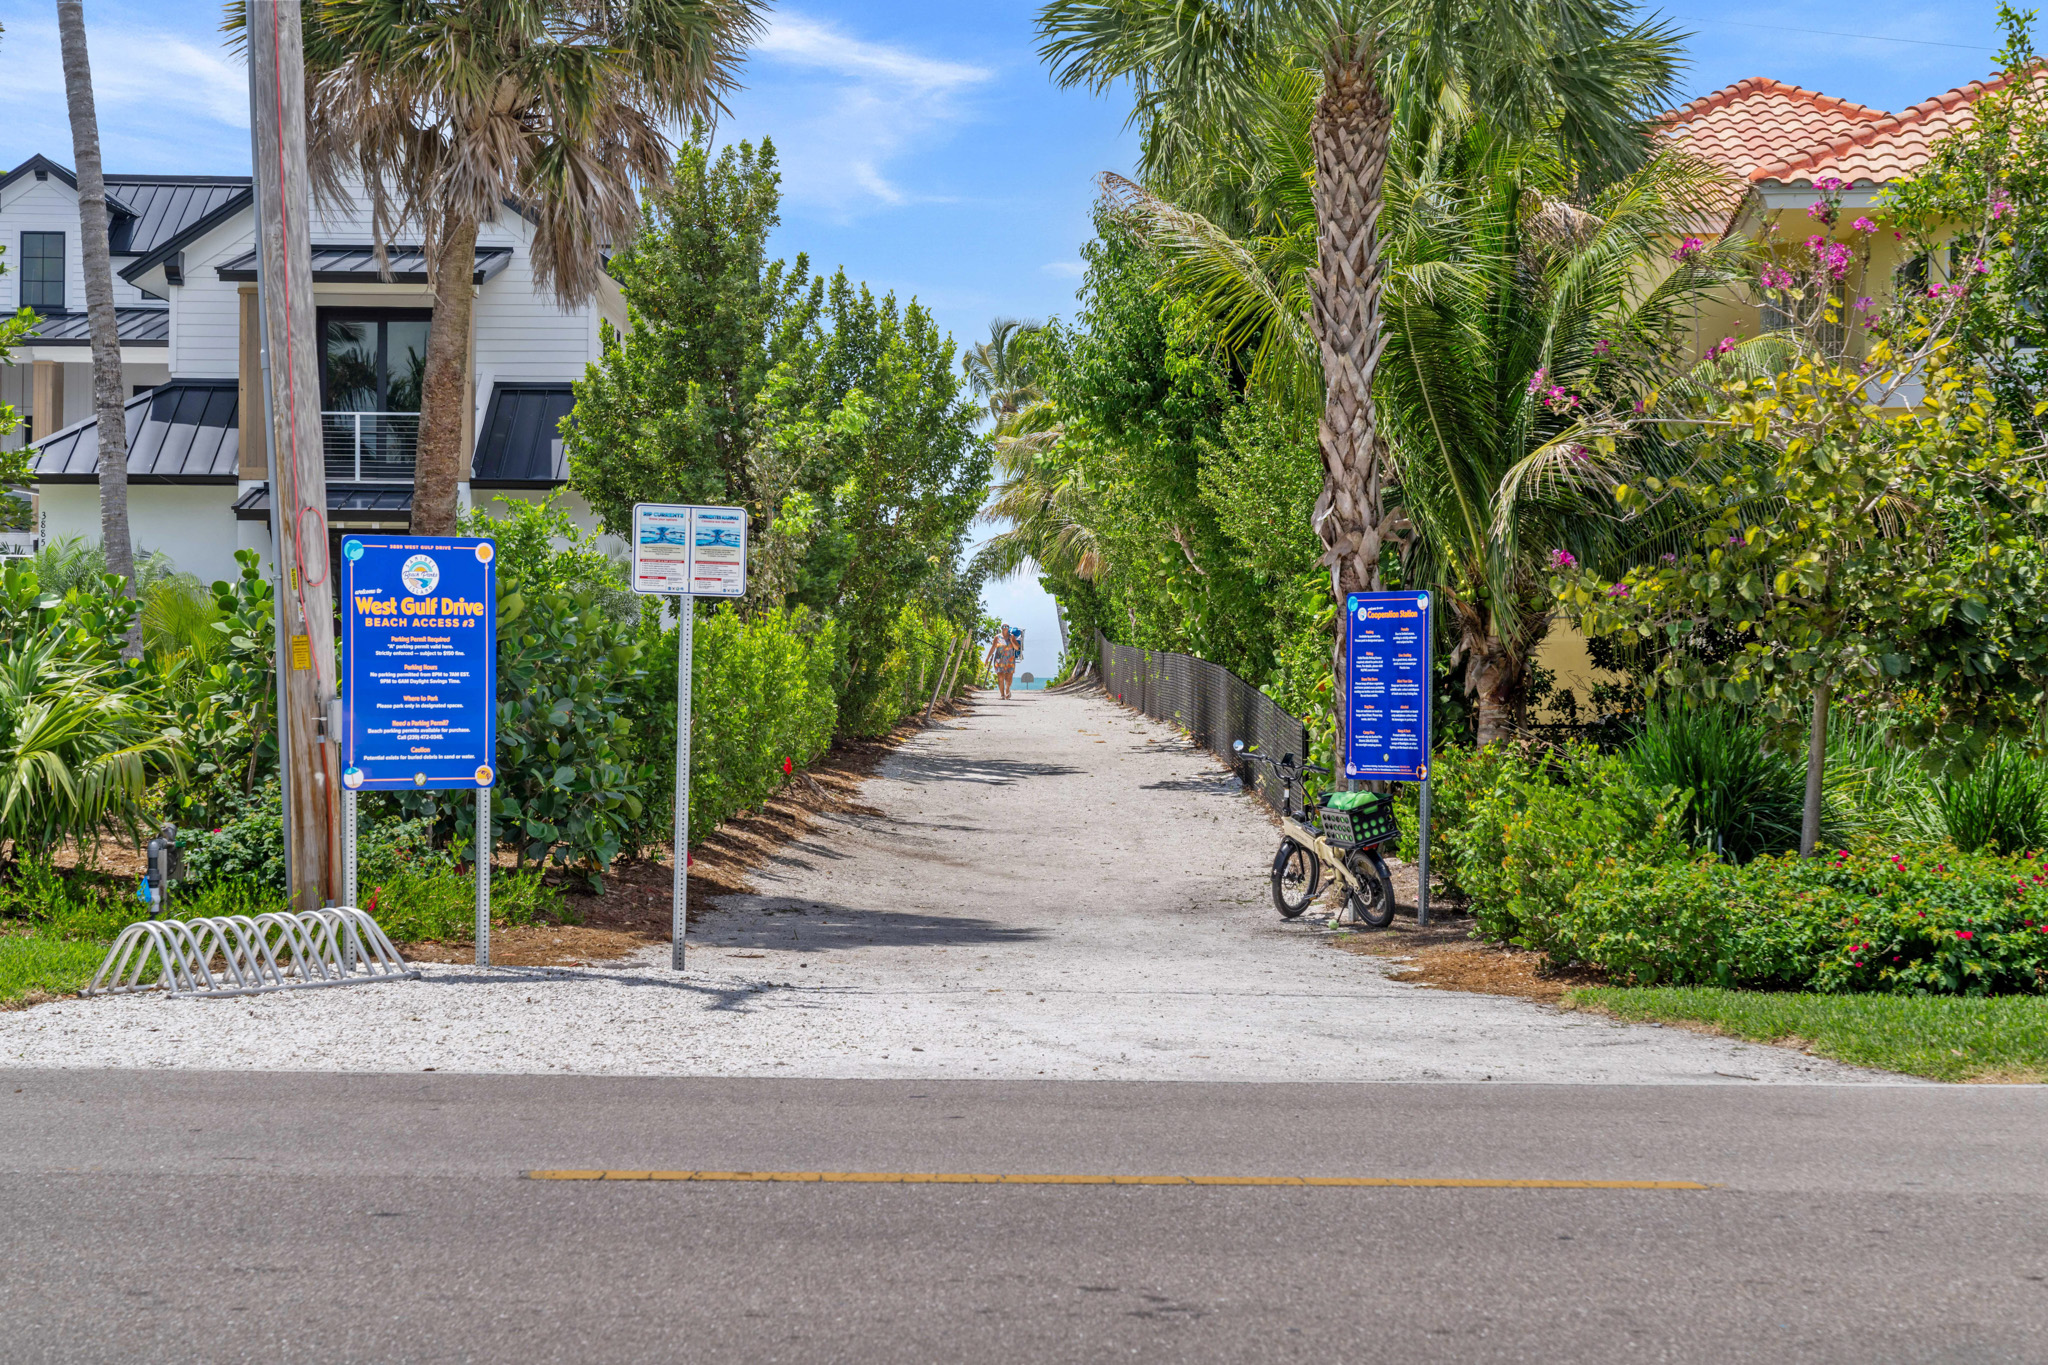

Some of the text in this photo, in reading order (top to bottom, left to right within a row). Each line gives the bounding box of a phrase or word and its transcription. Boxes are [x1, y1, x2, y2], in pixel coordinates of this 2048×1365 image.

[405, 556, 436, 568] SANIBEL
[403, 571, 419, 580] Beach
[355, 597, 484, 616] West Gulf Drive
[1367, 609, 1418, 620] Cooperation Station
[365, 618, 475, 627] BEACH ACCESS #3
